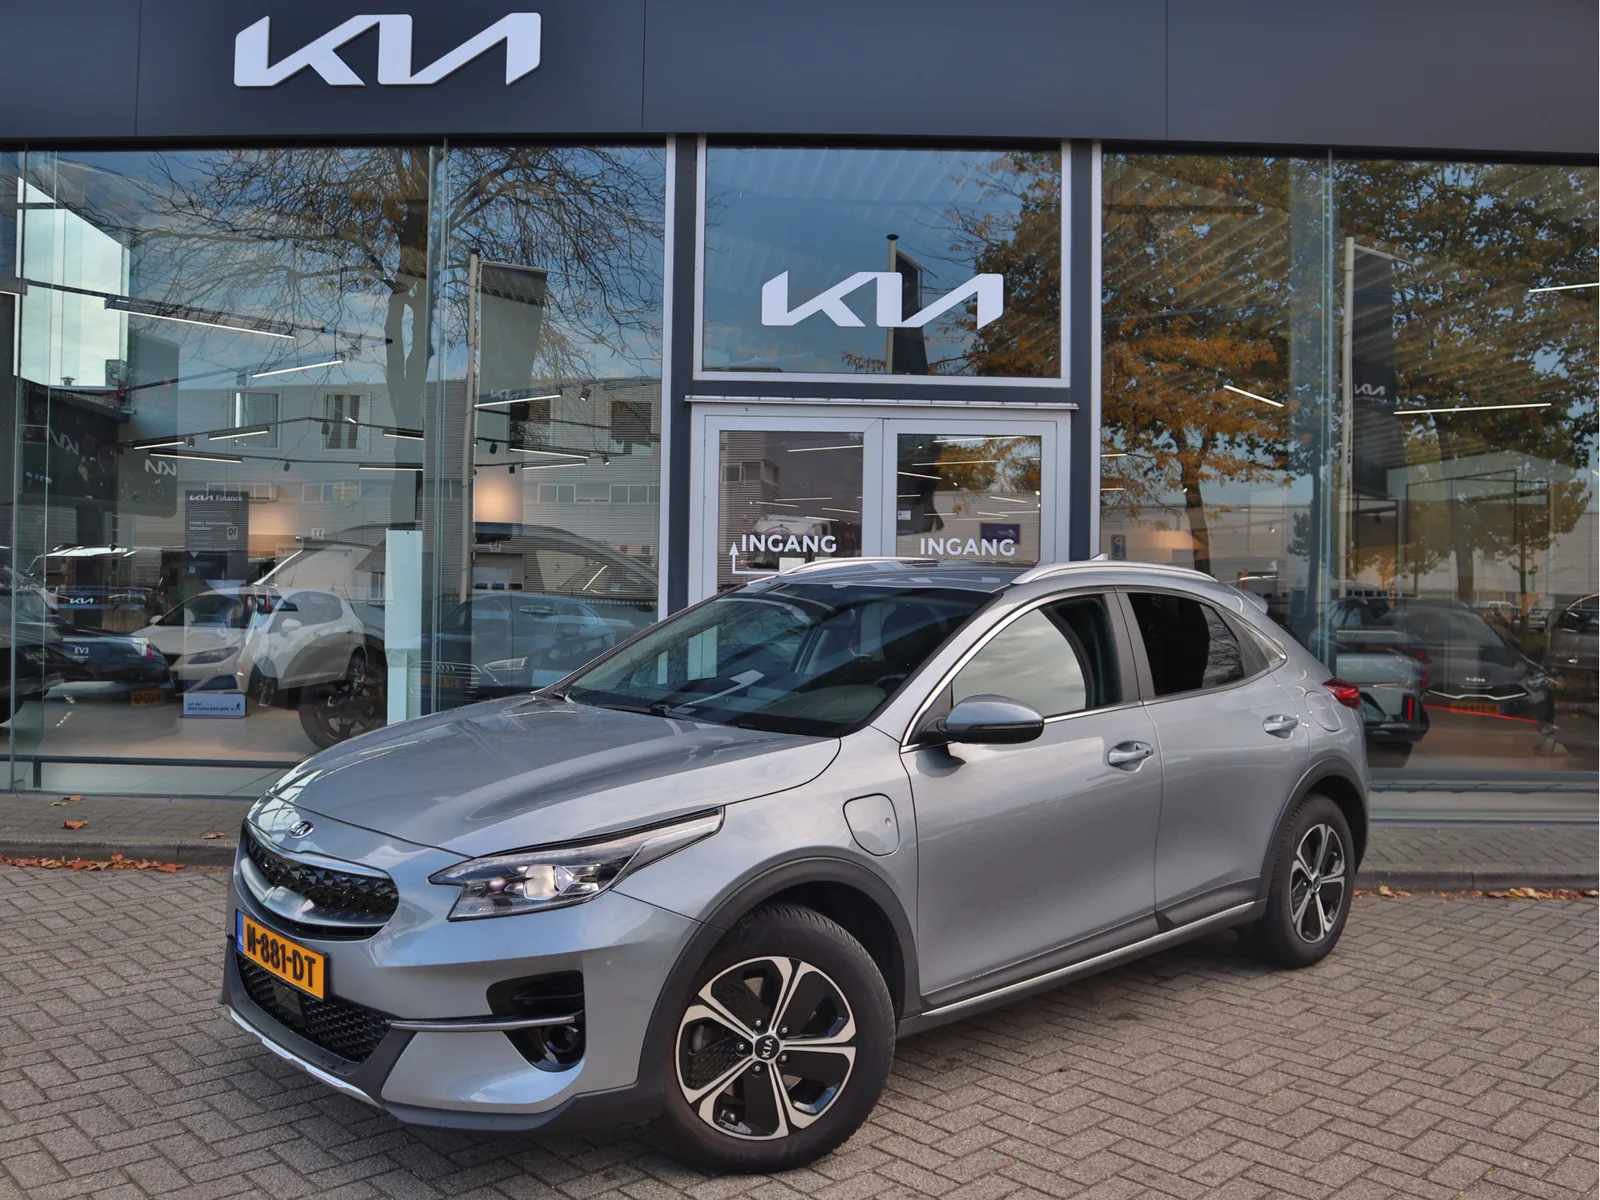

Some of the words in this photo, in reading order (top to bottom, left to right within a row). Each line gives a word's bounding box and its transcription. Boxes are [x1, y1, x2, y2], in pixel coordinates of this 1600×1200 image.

[233, 12, 541, 87] KIA
[761, 270, 1004, 329] KIA
[741, 534, 837, 553] INGANG
[920, 537, 1016, 557] INGANG
[74, 646, 89, 654] EV3
[246, 923, 317, 988] N-881-DT
[761, 1038, 774, 1058] KIA
